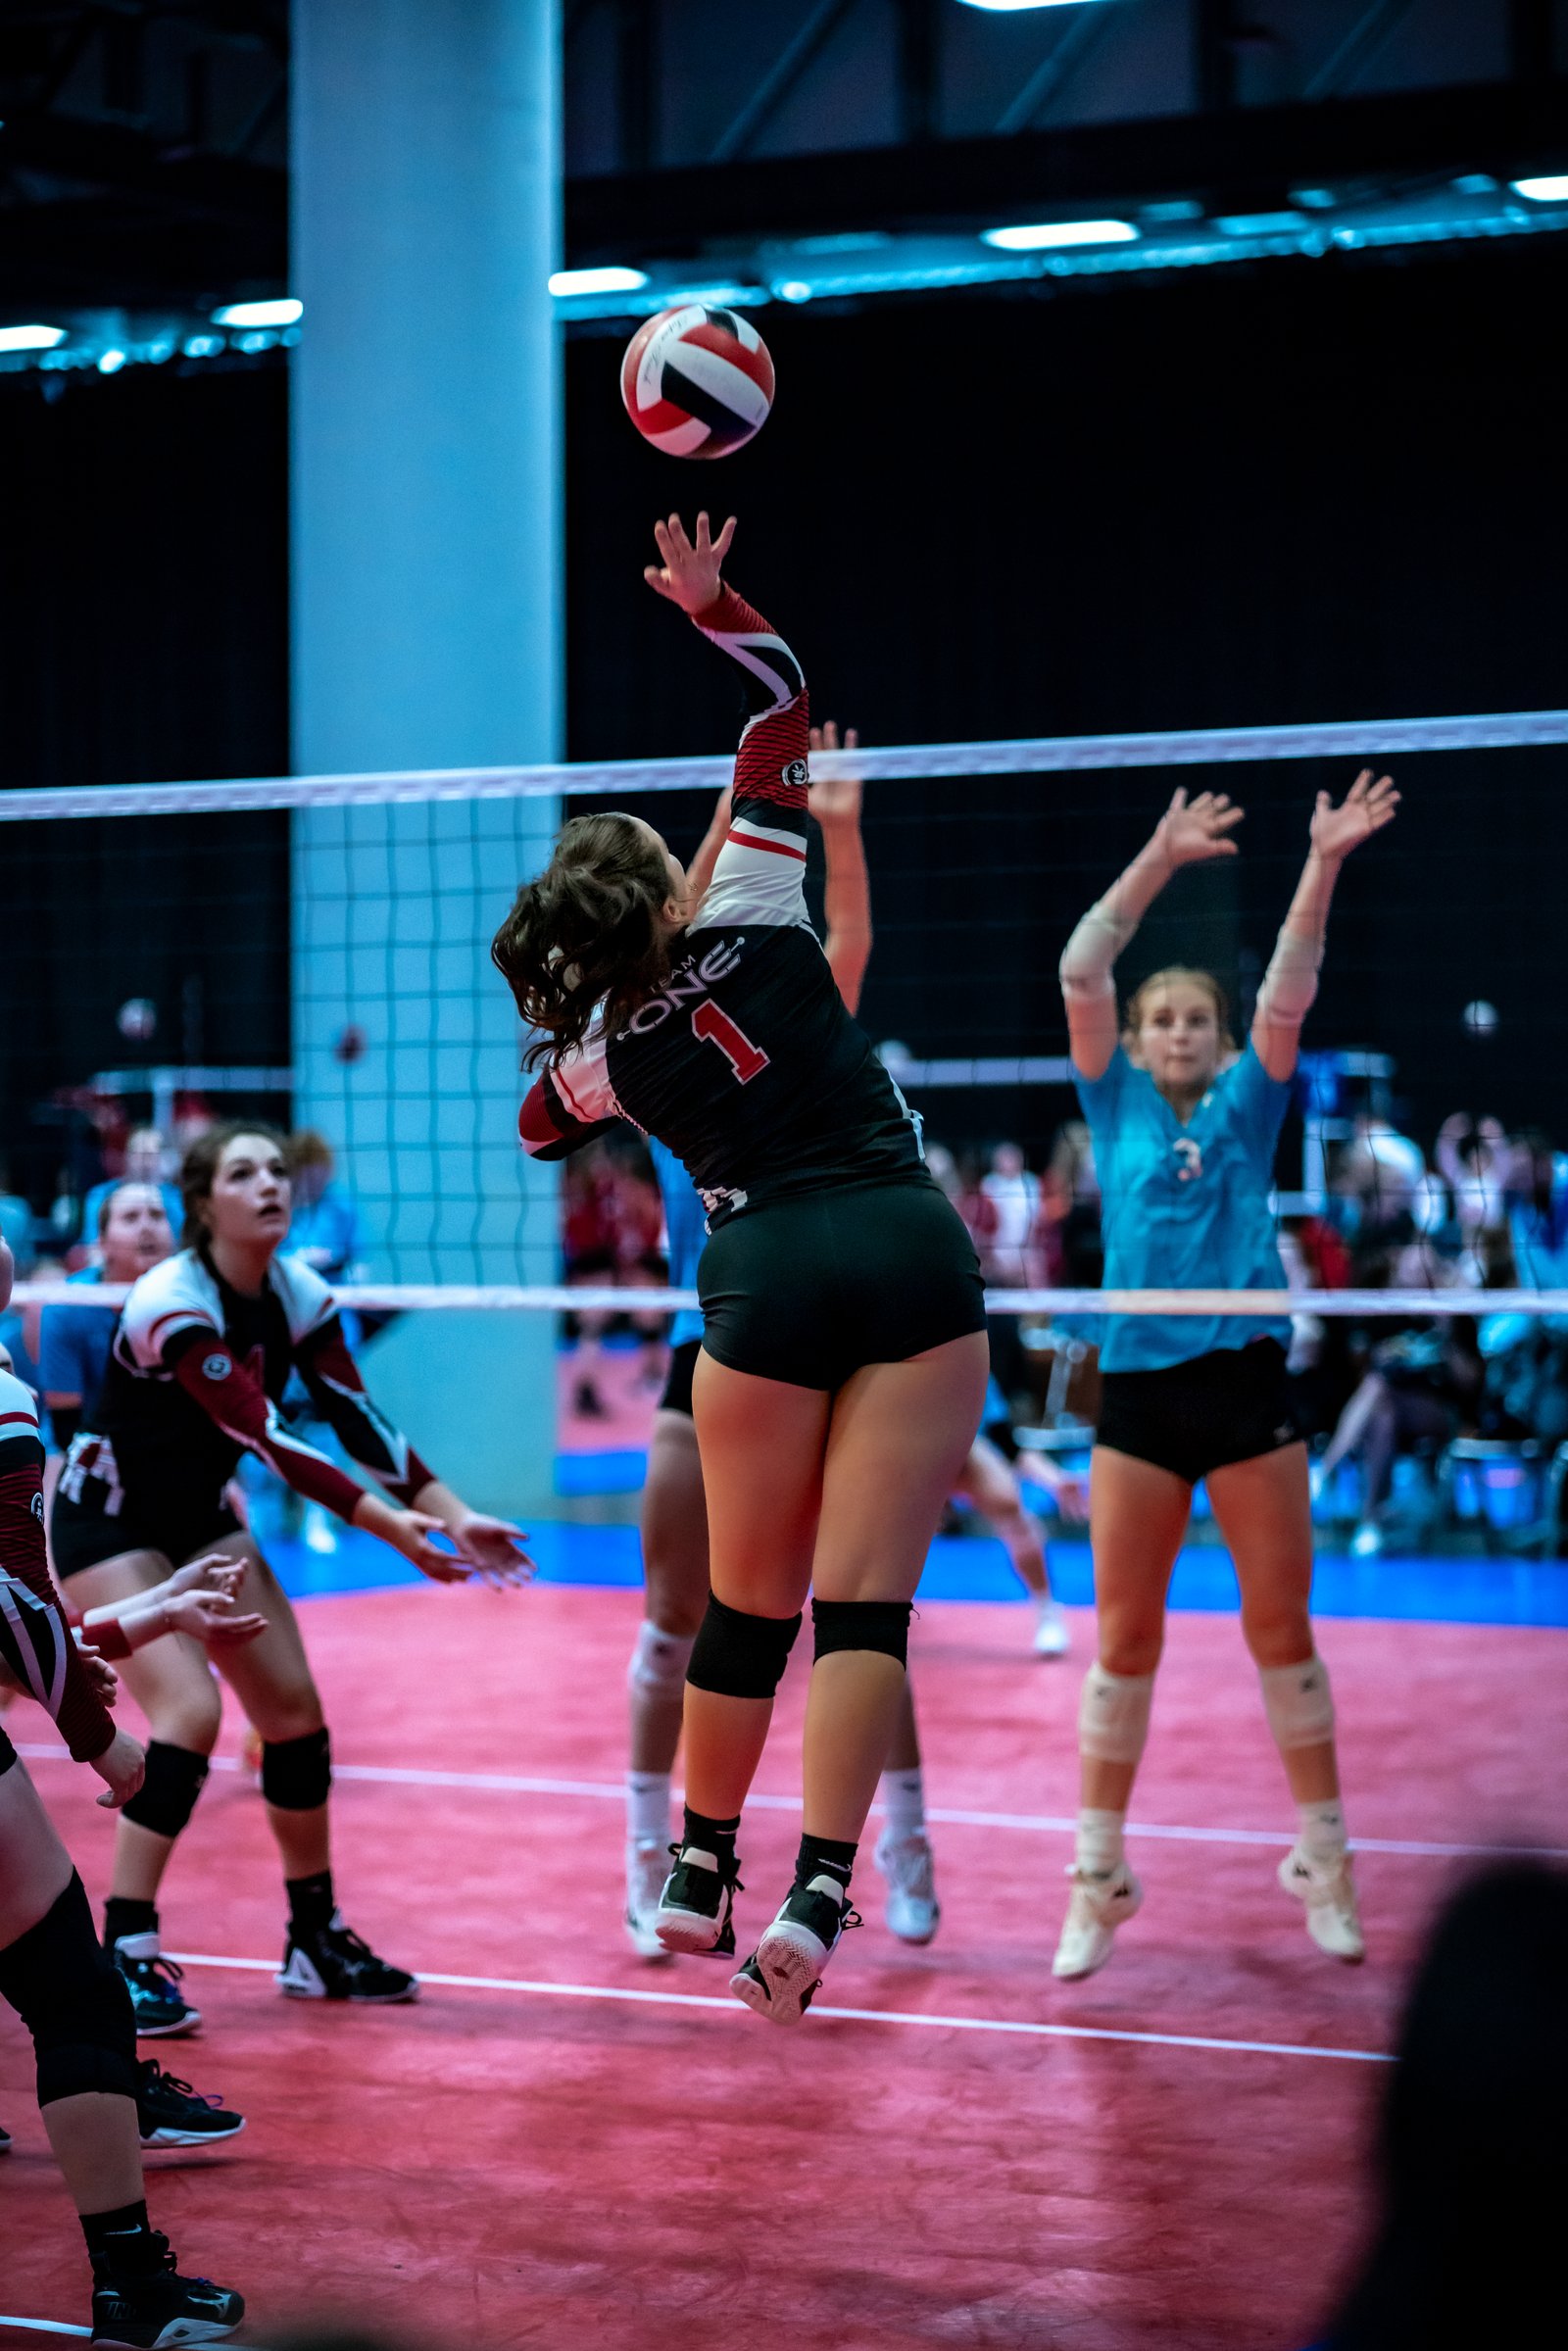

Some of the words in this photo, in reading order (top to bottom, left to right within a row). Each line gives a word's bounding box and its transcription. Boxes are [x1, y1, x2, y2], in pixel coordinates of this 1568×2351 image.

[629, 940, 742, 1035] ONE
[648, 955, 696, 994] TEAM
[691, 998, 771, 1085] 1
